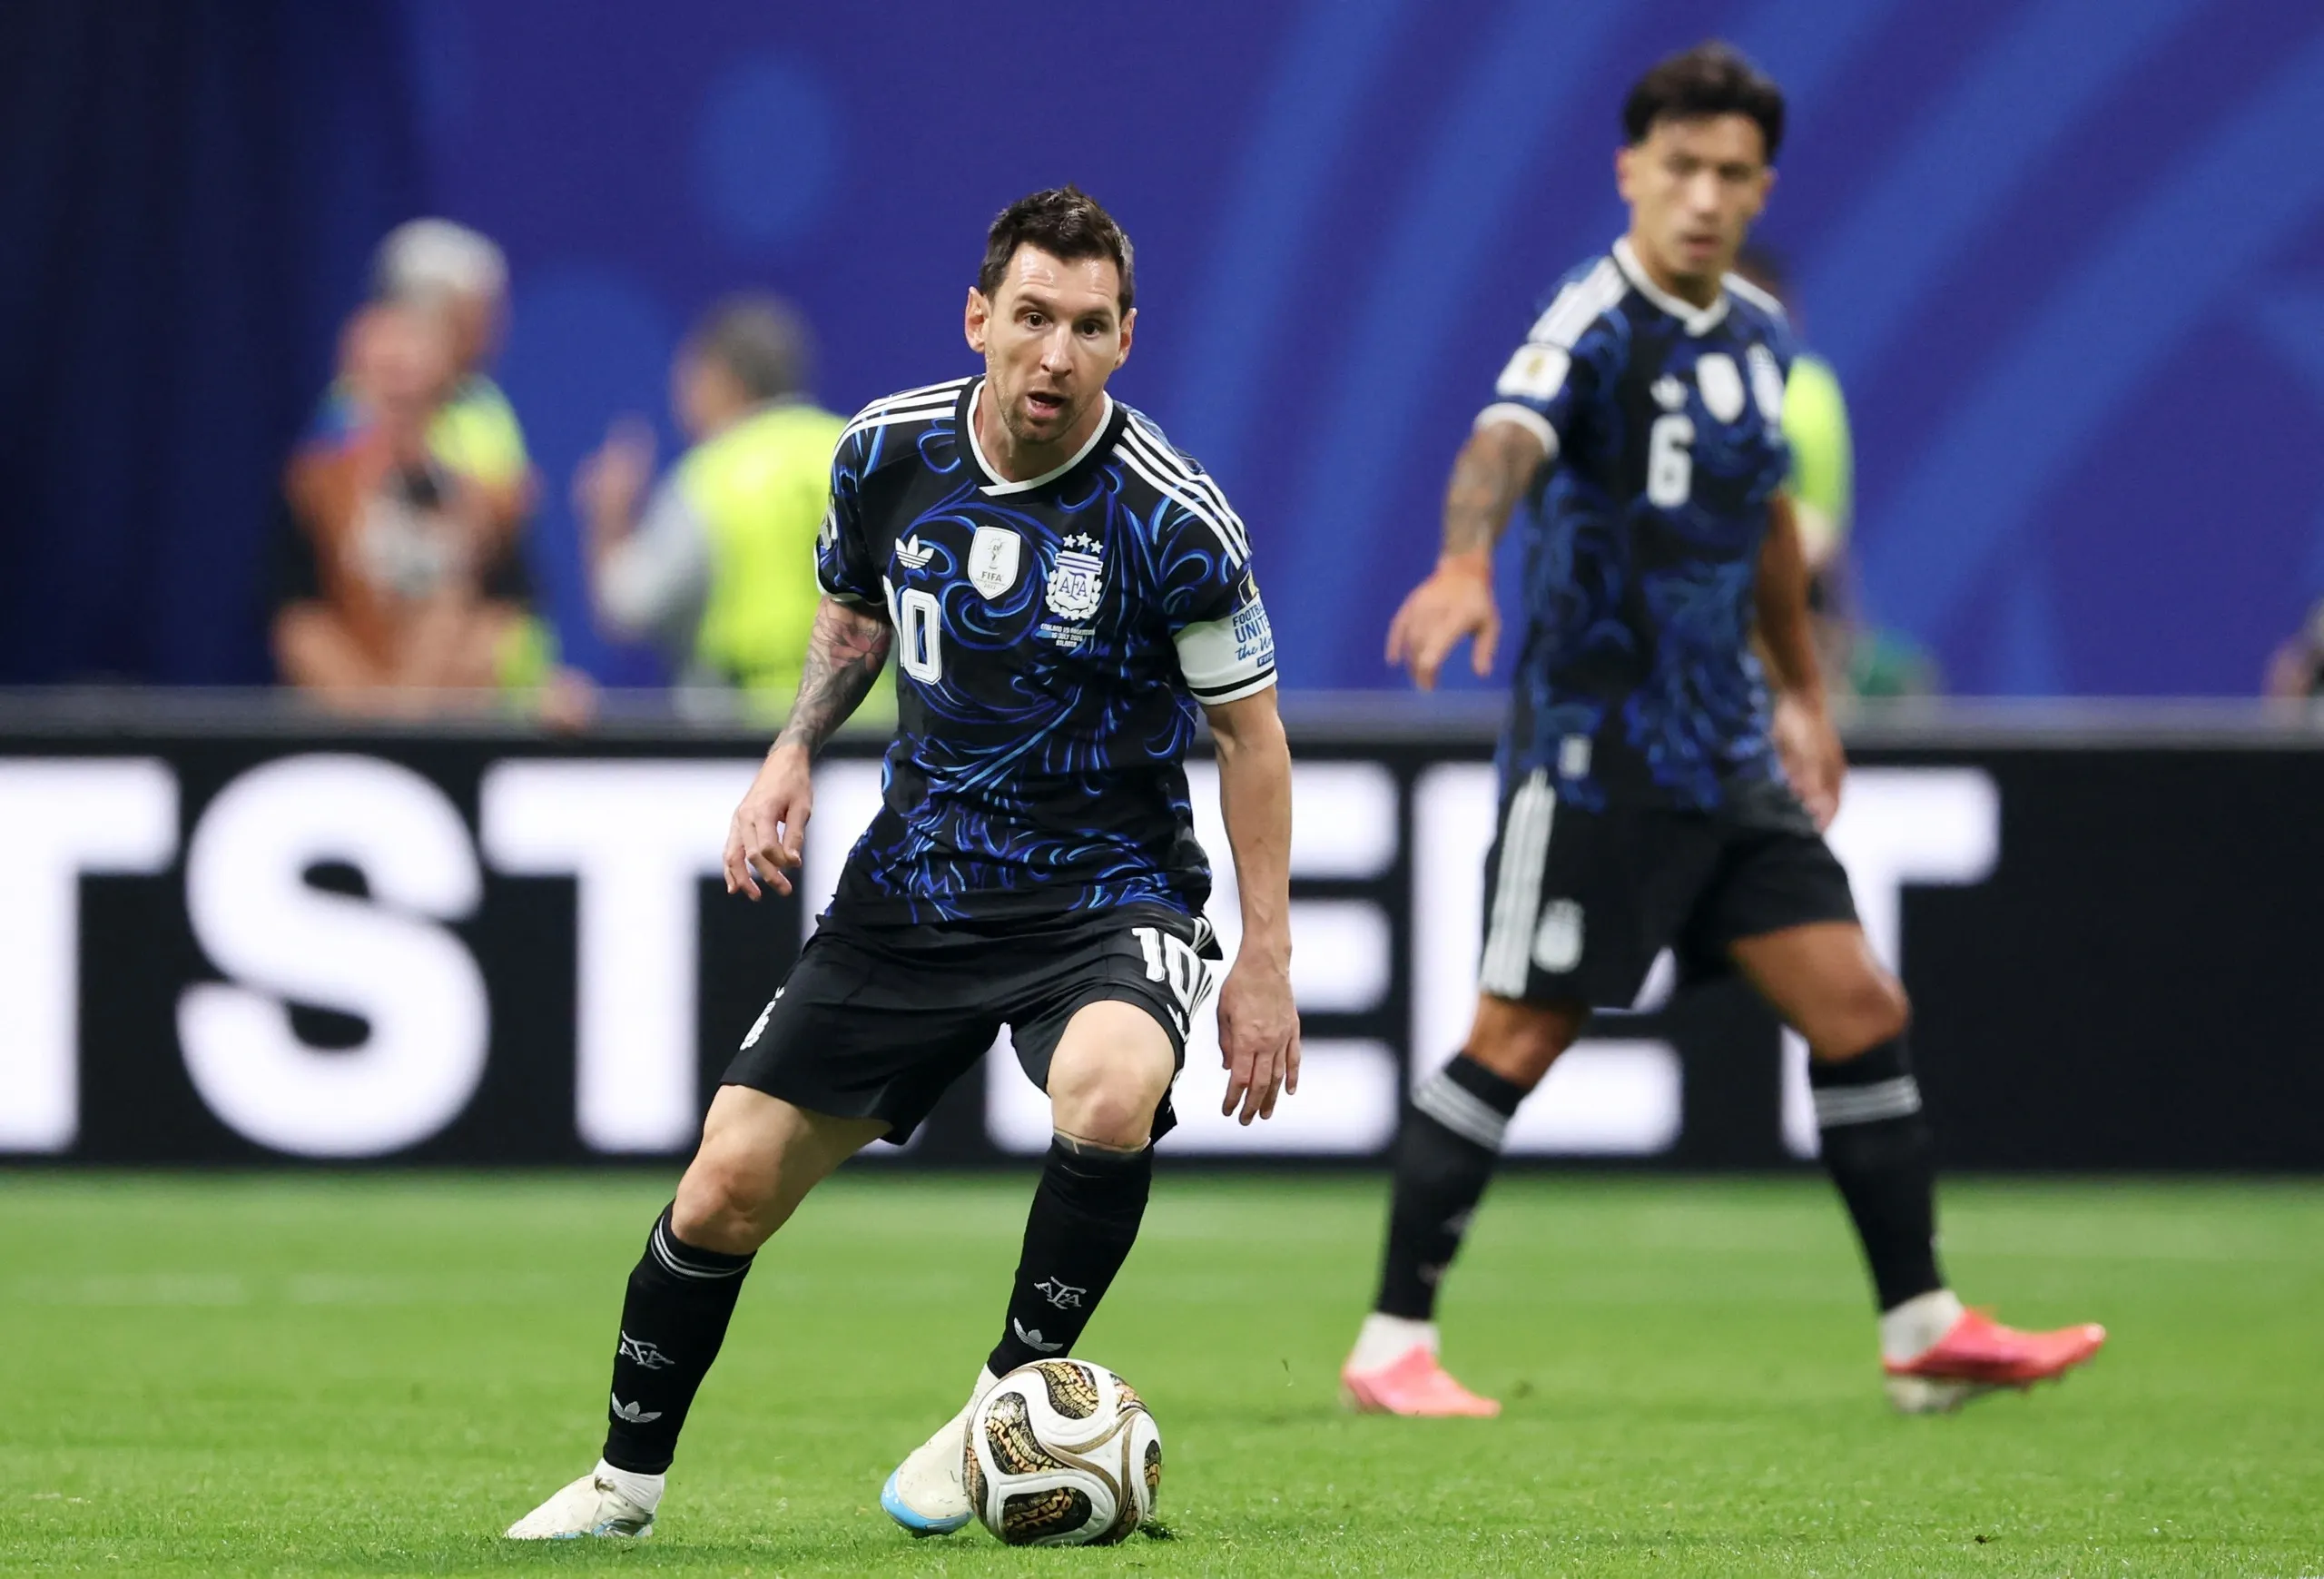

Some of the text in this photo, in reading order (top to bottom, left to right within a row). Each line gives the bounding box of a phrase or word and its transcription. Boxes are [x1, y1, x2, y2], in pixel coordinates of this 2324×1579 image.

[1647, 414, 1696, 508] 6
[981, 571, 1002, 582] FIFA
[1235, 644, 1258, 661] the
[1131, 927, 1201, 1016] 10
